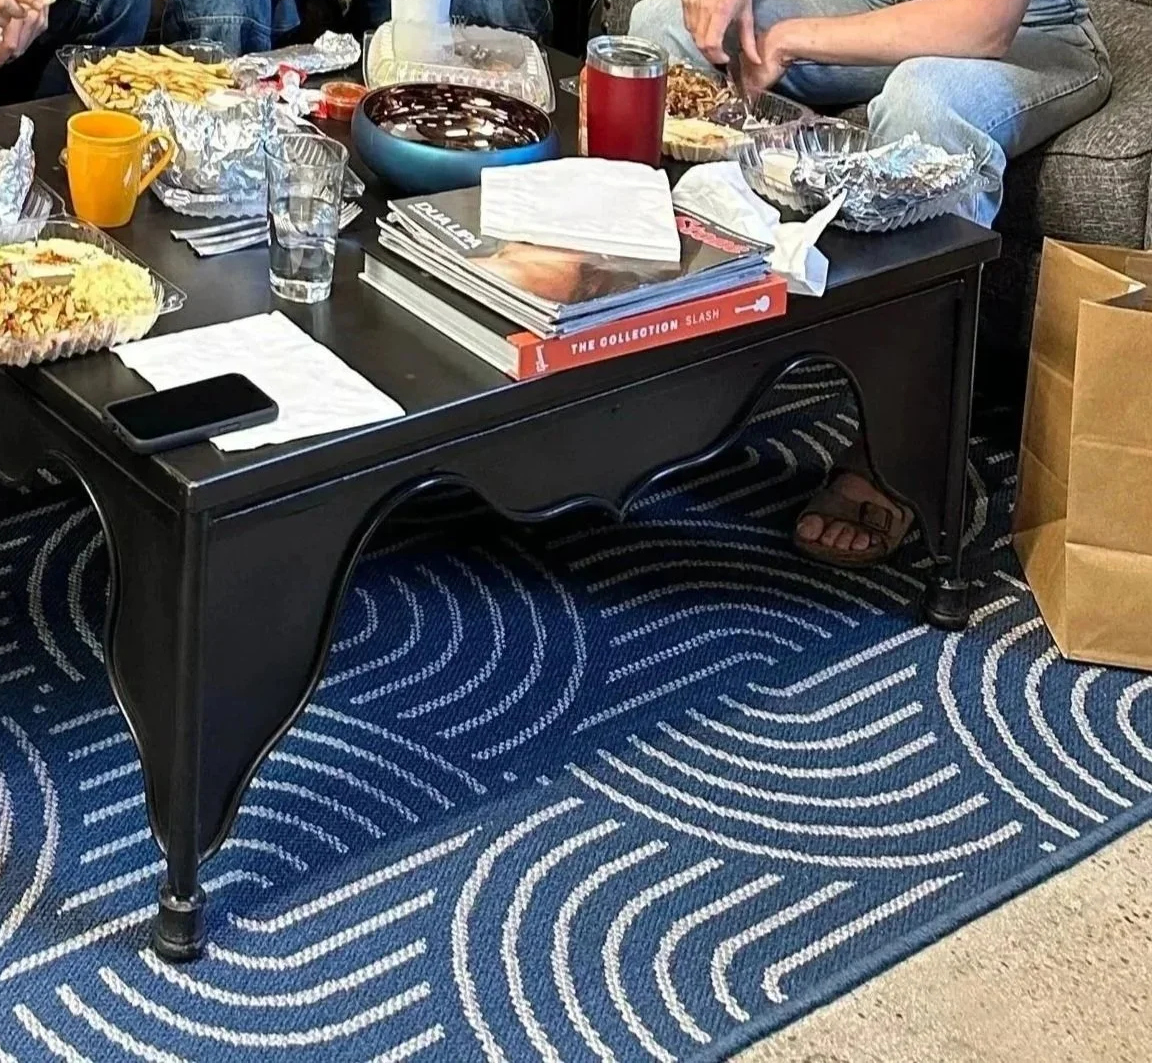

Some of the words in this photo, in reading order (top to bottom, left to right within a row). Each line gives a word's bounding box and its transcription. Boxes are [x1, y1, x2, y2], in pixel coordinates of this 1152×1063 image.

[414, 202, 452, 226] DUA
[446, 224, 482, 249] LIPA
[570, 340, 595, 355] THE
[599, 319, 678, 348] COLLECTION
[685, 309, 721, 326] SLASH
